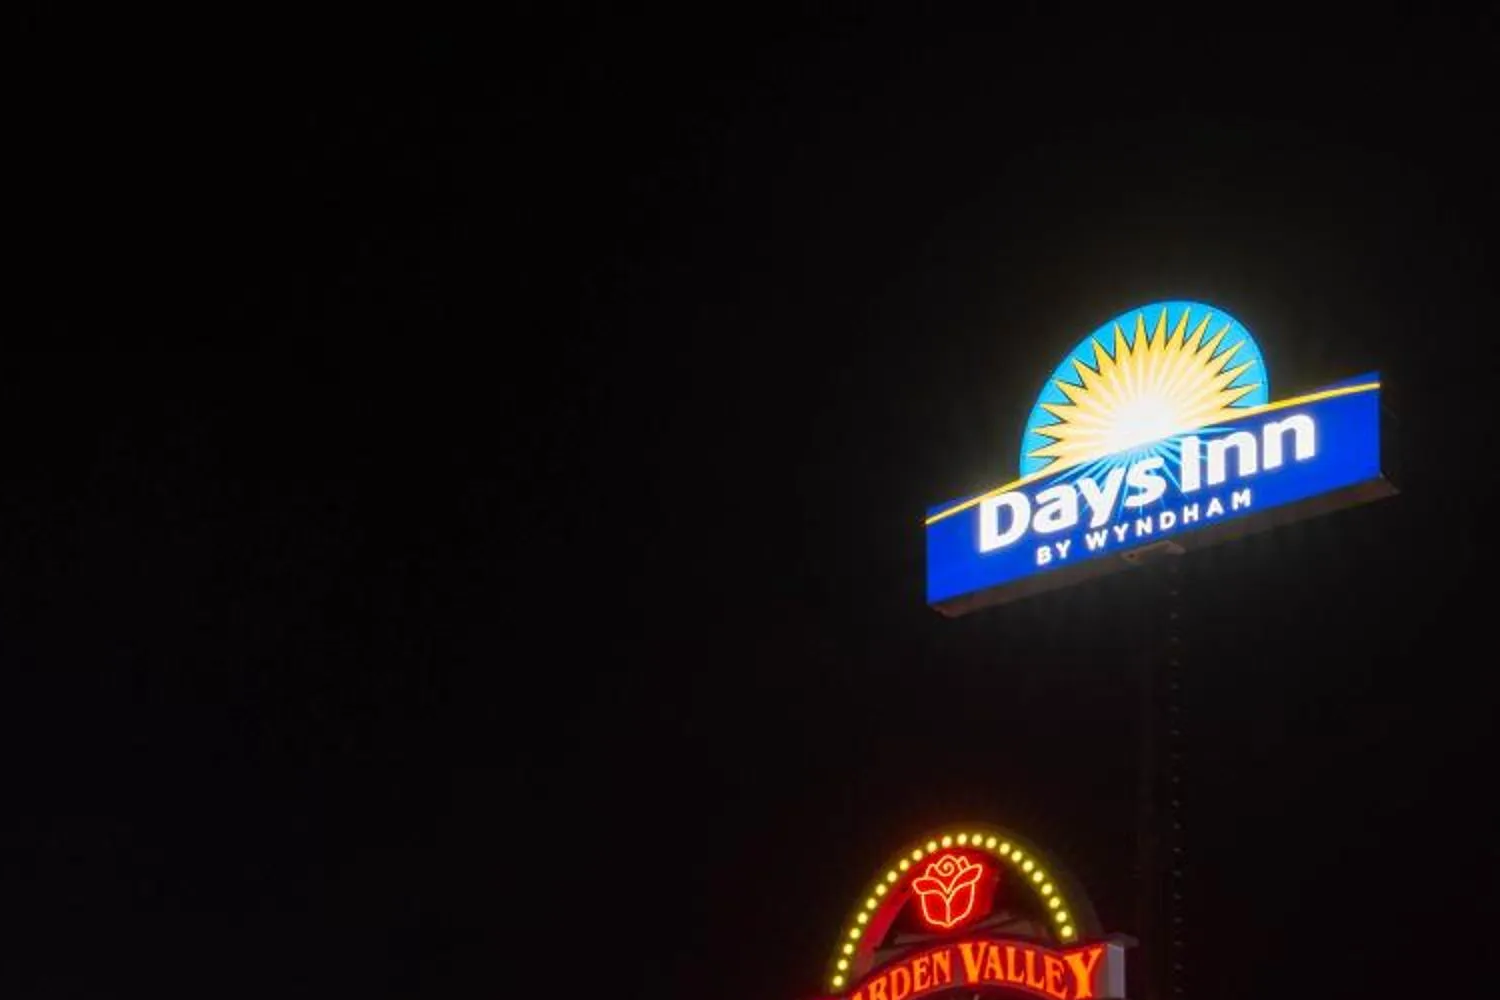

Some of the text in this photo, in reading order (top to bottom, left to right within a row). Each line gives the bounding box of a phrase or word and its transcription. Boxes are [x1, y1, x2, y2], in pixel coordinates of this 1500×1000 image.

[978, 413, 1316, 553] Days Inn
[1036, 489, 1252, 566] BY WYNDHAM
